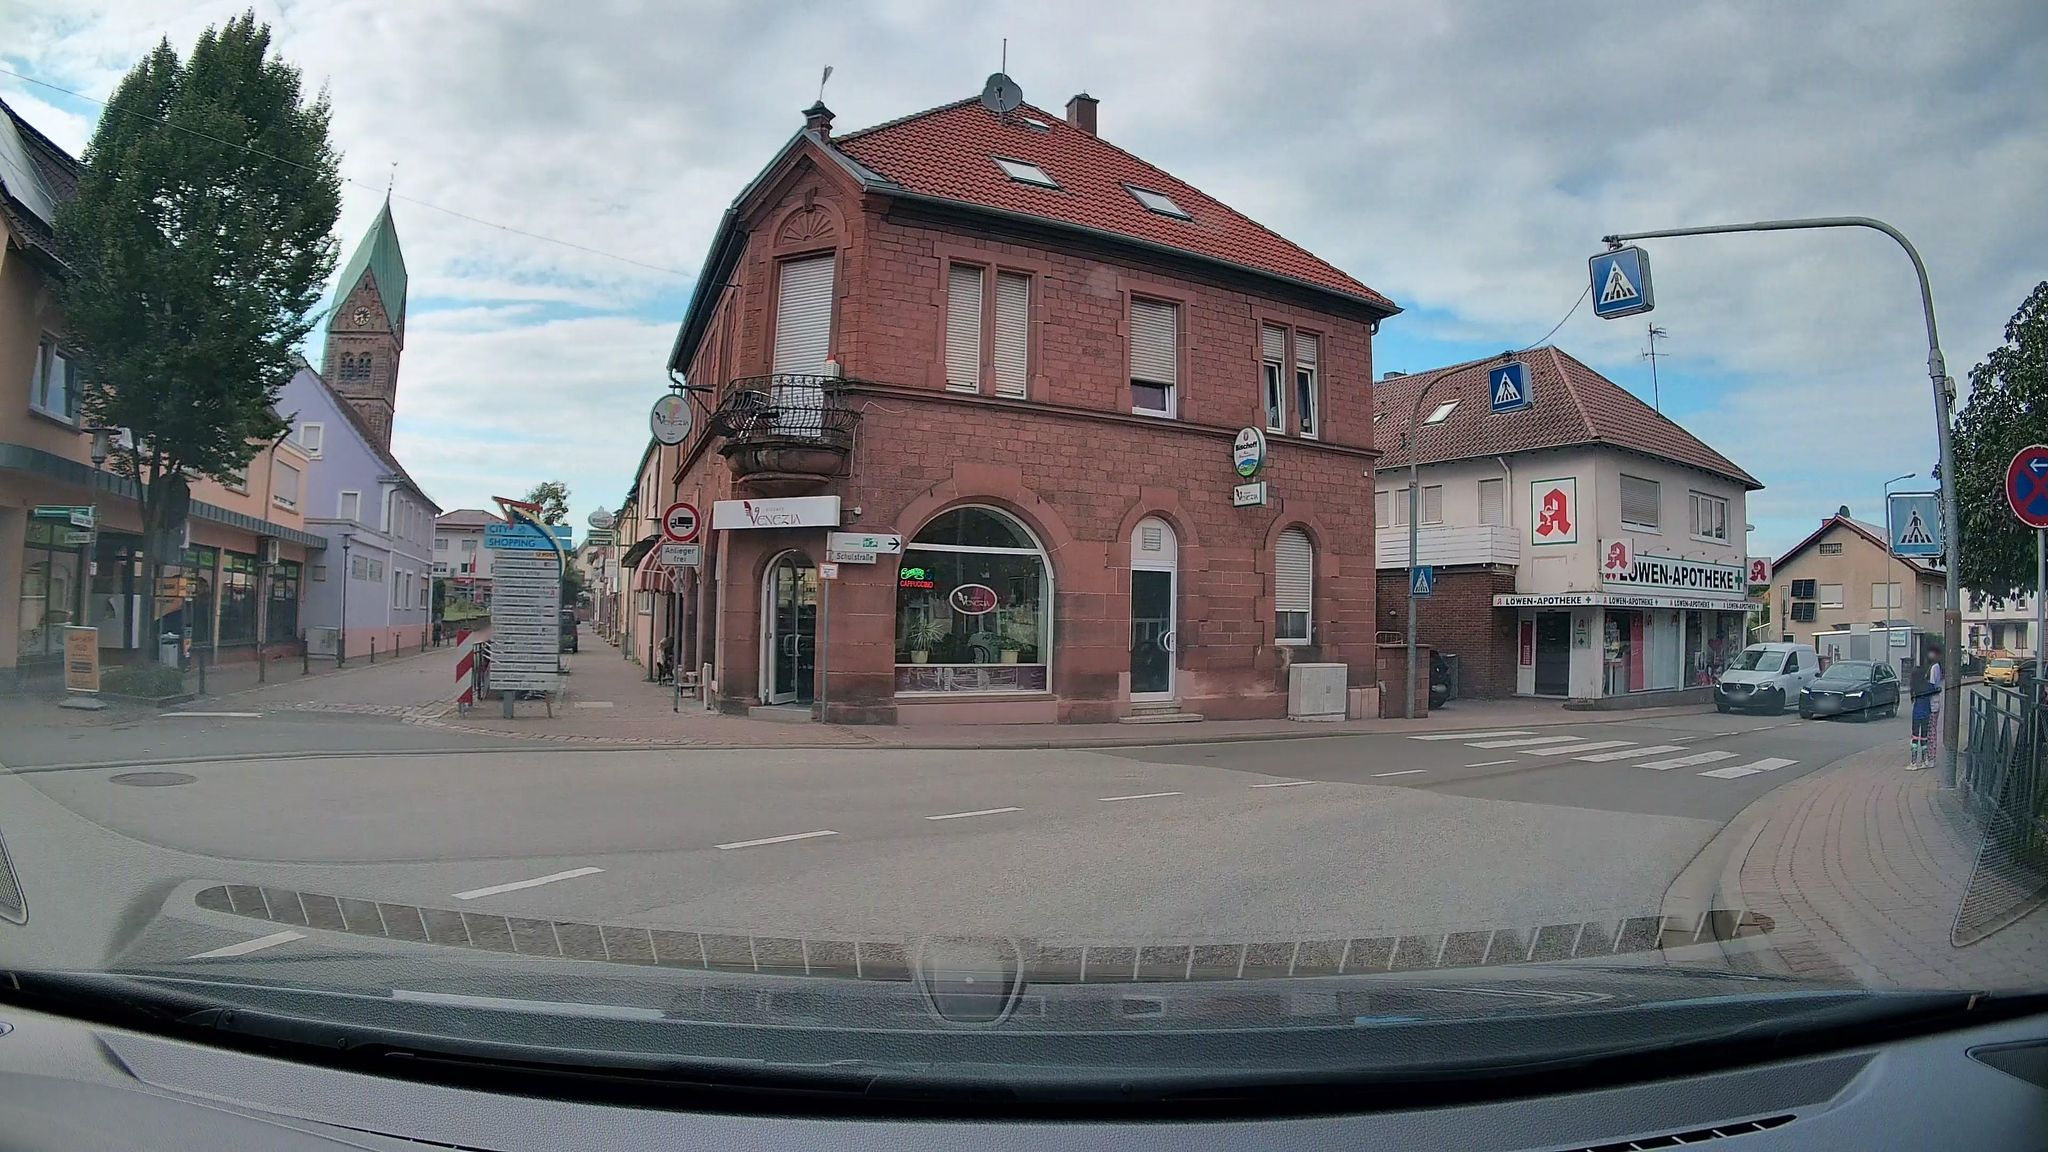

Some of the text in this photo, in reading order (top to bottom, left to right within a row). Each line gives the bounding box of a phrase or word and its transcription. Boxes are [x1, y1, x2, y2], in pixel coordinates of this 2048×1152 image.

[489, 525, 508, 533] CITY
[489, 538, 536, 547] SHOPPING
[664, 547, 695, 555] Anlieger
[836, 553, 874, 561] Schulstraße
[1505, 596, 1582, 606] LÖWEN-APOTHEKE
